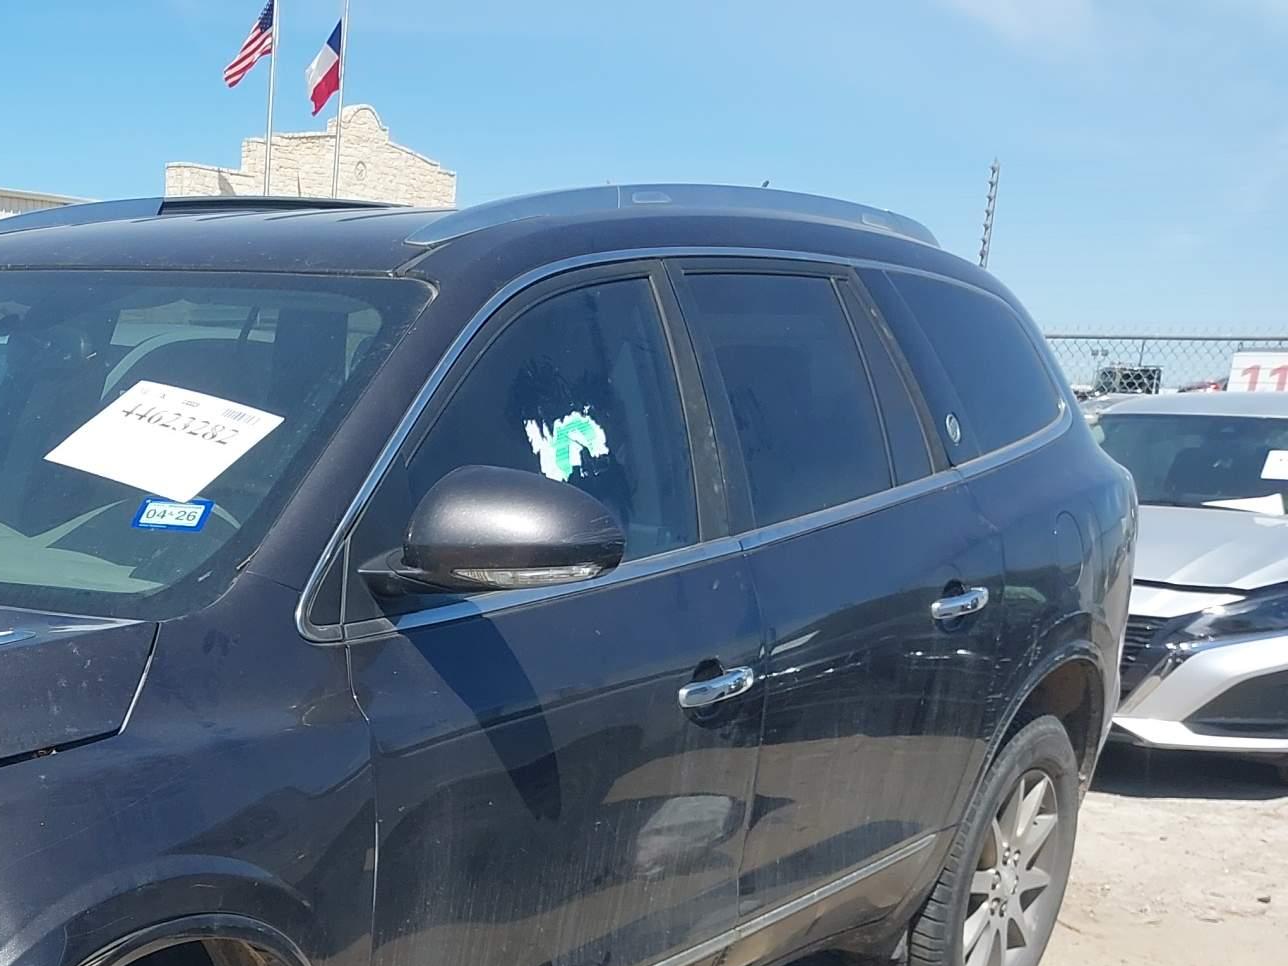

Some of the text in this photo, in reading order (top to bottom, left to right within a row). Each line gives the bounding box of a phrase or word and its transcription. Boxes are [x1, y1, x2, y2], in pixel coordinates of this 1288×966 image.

[122, 403, 239, 445] 44623282
[146, 508, 198, 522] 04 26
